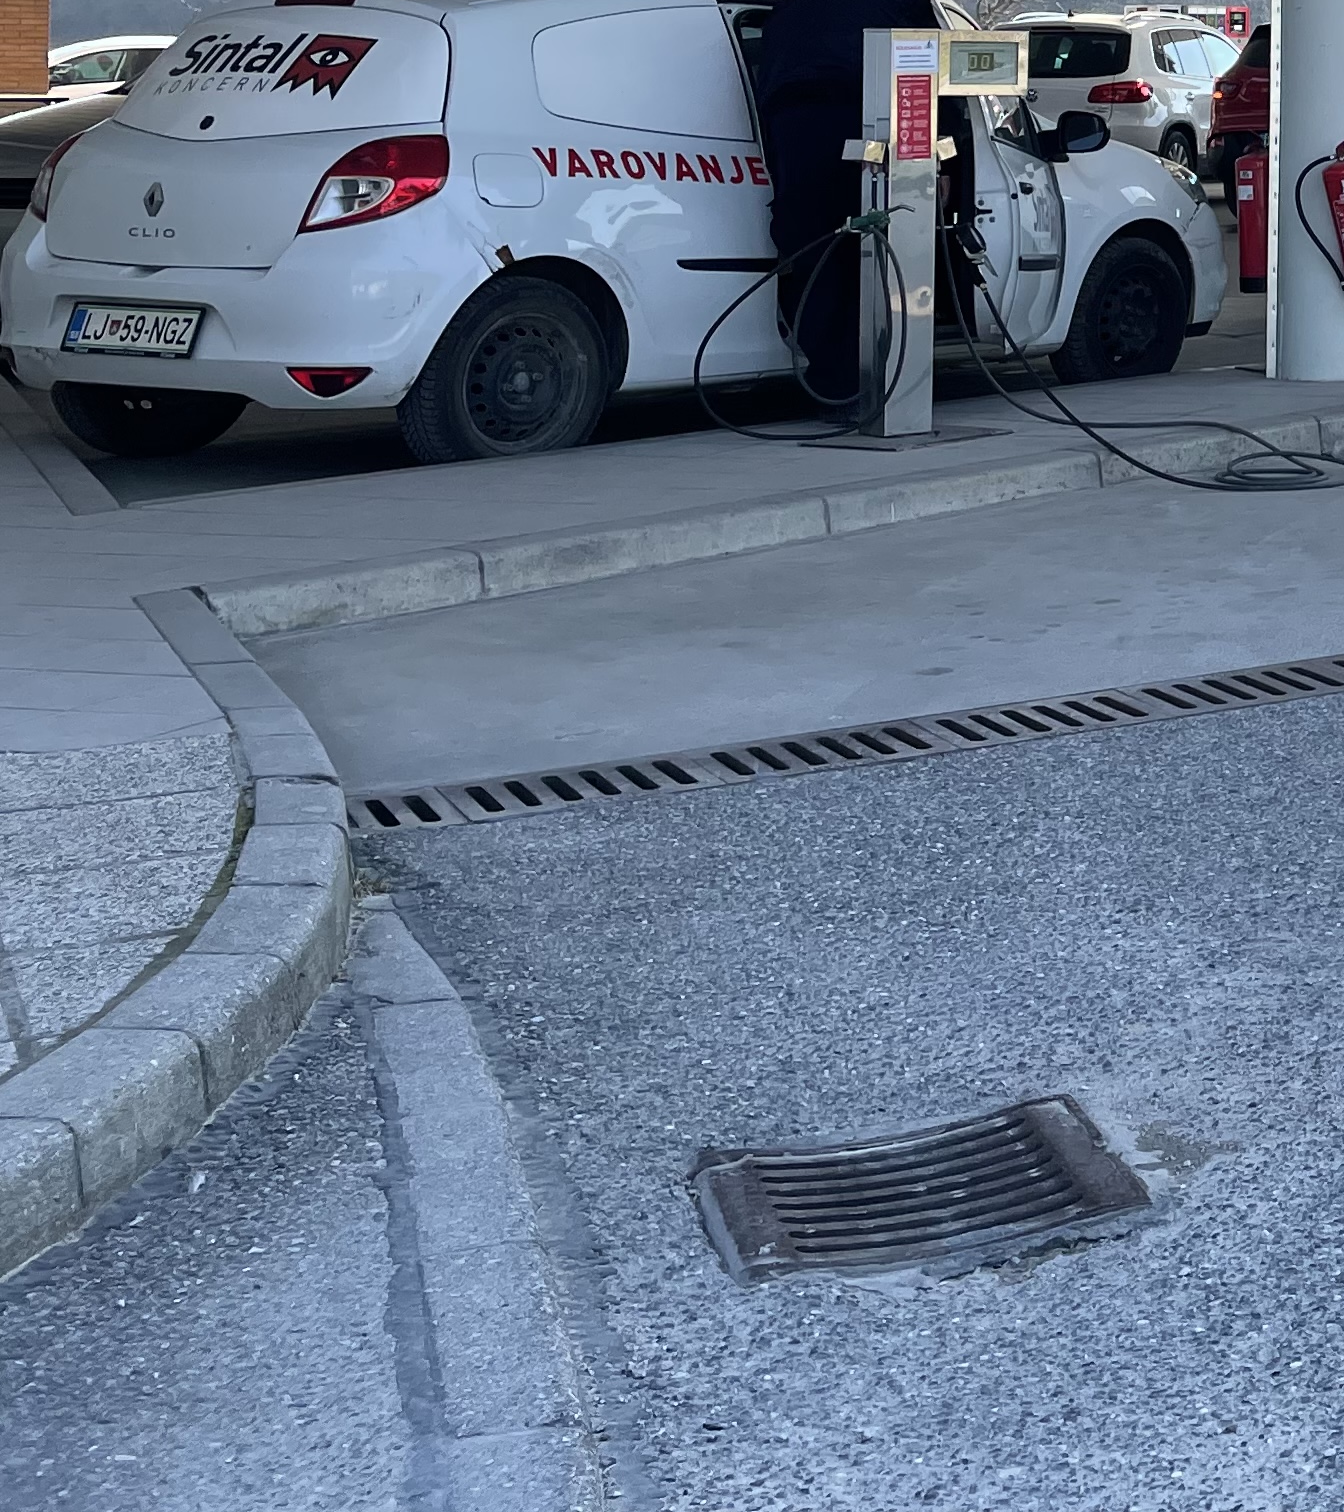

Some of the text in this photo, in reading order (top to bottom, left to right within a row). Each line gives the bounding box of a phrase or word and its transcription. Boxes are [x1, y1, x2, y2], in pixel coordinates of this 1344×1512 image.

[168, 33, 310, 77] Sintal
[153, 76, 271, 97] KONCERN
[531, 146, 771, 186] VAROVANJE
[128, 227, 176, 239] CLIO
[81, 312, 194, 346] LJ 59-NGZ
